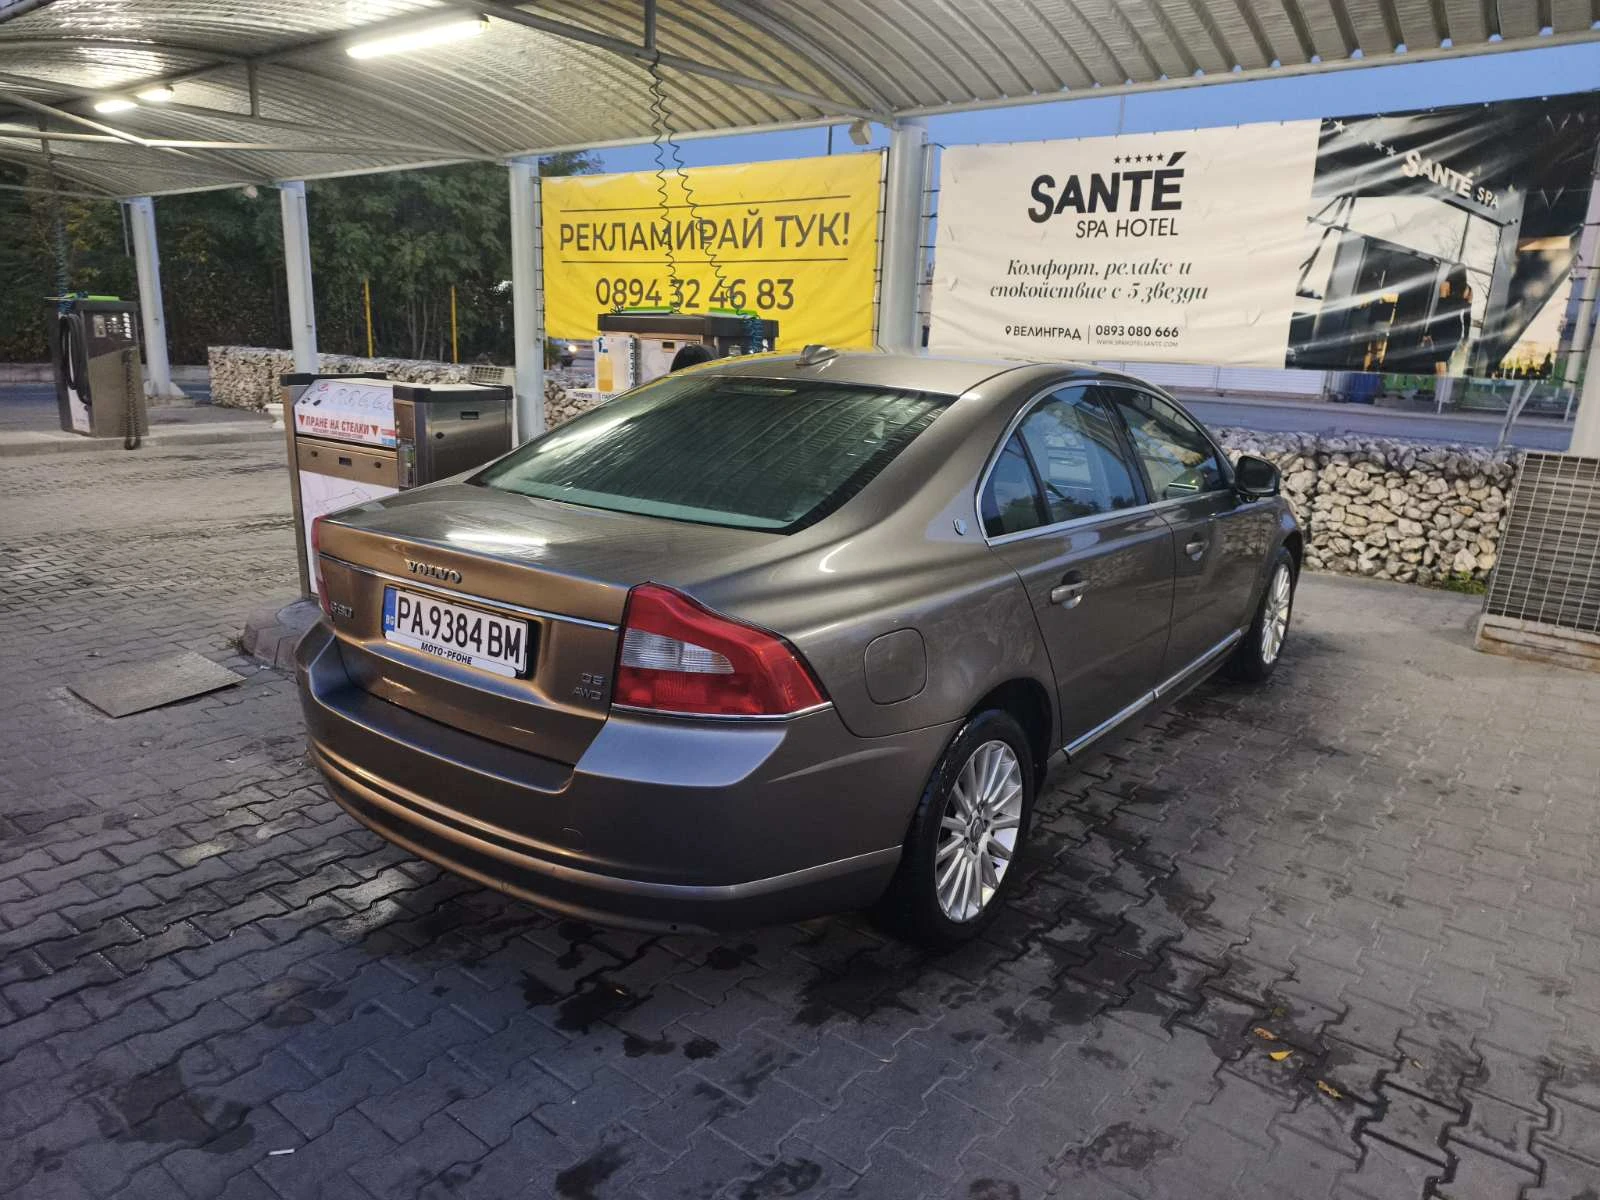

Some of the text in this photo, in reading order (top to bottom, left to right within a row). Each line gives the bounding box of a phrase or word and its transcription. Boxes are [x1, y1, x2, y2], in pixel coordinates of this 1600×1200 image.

[1027, 151, 1187, 223] SANTÉ
[1402, 150, 1500, 209] SANTÉ SPA
[560, 208, 850, 251] РЕКЛАМИРАЙ ТУК!
[1075, 217, 1179, 238] SPA HOTEL
[1007, 257, 1192, 280] Комфорт, релакс и
[595, 278, 794, 310] 0894 32 46 83
[990, 281, 1209, 304] спокойствие с 5 звезди
[1013, 325, 1082, 340] ВЕЛИНГРАД
[1095, 325, 1179, 338] 0893 080 666
[305, 415, 329, 429] ПРАНЕ
[330, 420, 340, 431] НА
[341, 420, 369, 435] СТЕЛКИ
[404, 558, 462, 584] VOLVO
